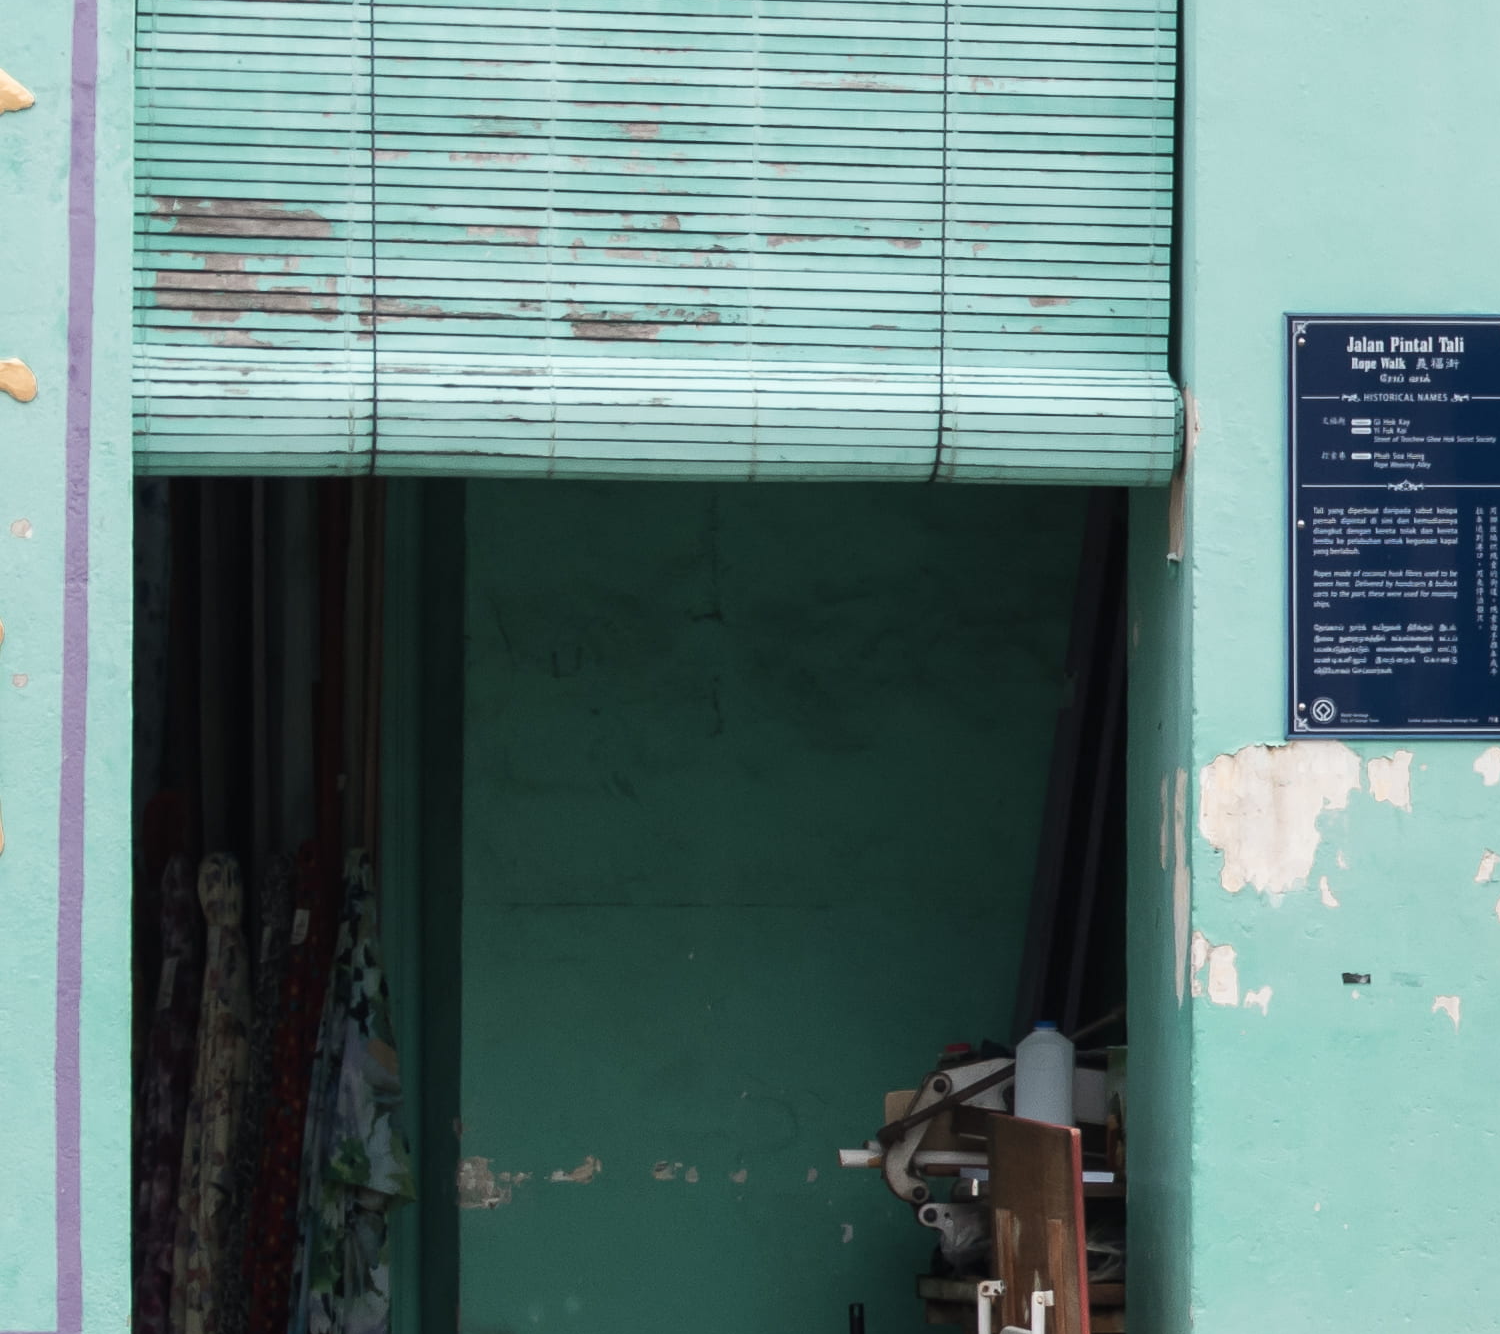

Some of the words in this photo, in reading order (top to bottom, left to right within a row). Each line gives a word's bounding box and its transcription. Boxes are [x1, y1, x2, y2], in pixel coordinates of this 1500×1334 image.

[1347, 336, 1384, 353] Jalan
[1390, 336, 1433, 353] Pintal
[1438, 336, 1464, 353] Tali
[1351, 357, 1377, 372] Rope
[1381, 357, 1406, 369] Walk
[1364, 393, 1414, 402] HISTORICAL
[1417, 393, 1448, 402] NAMES
